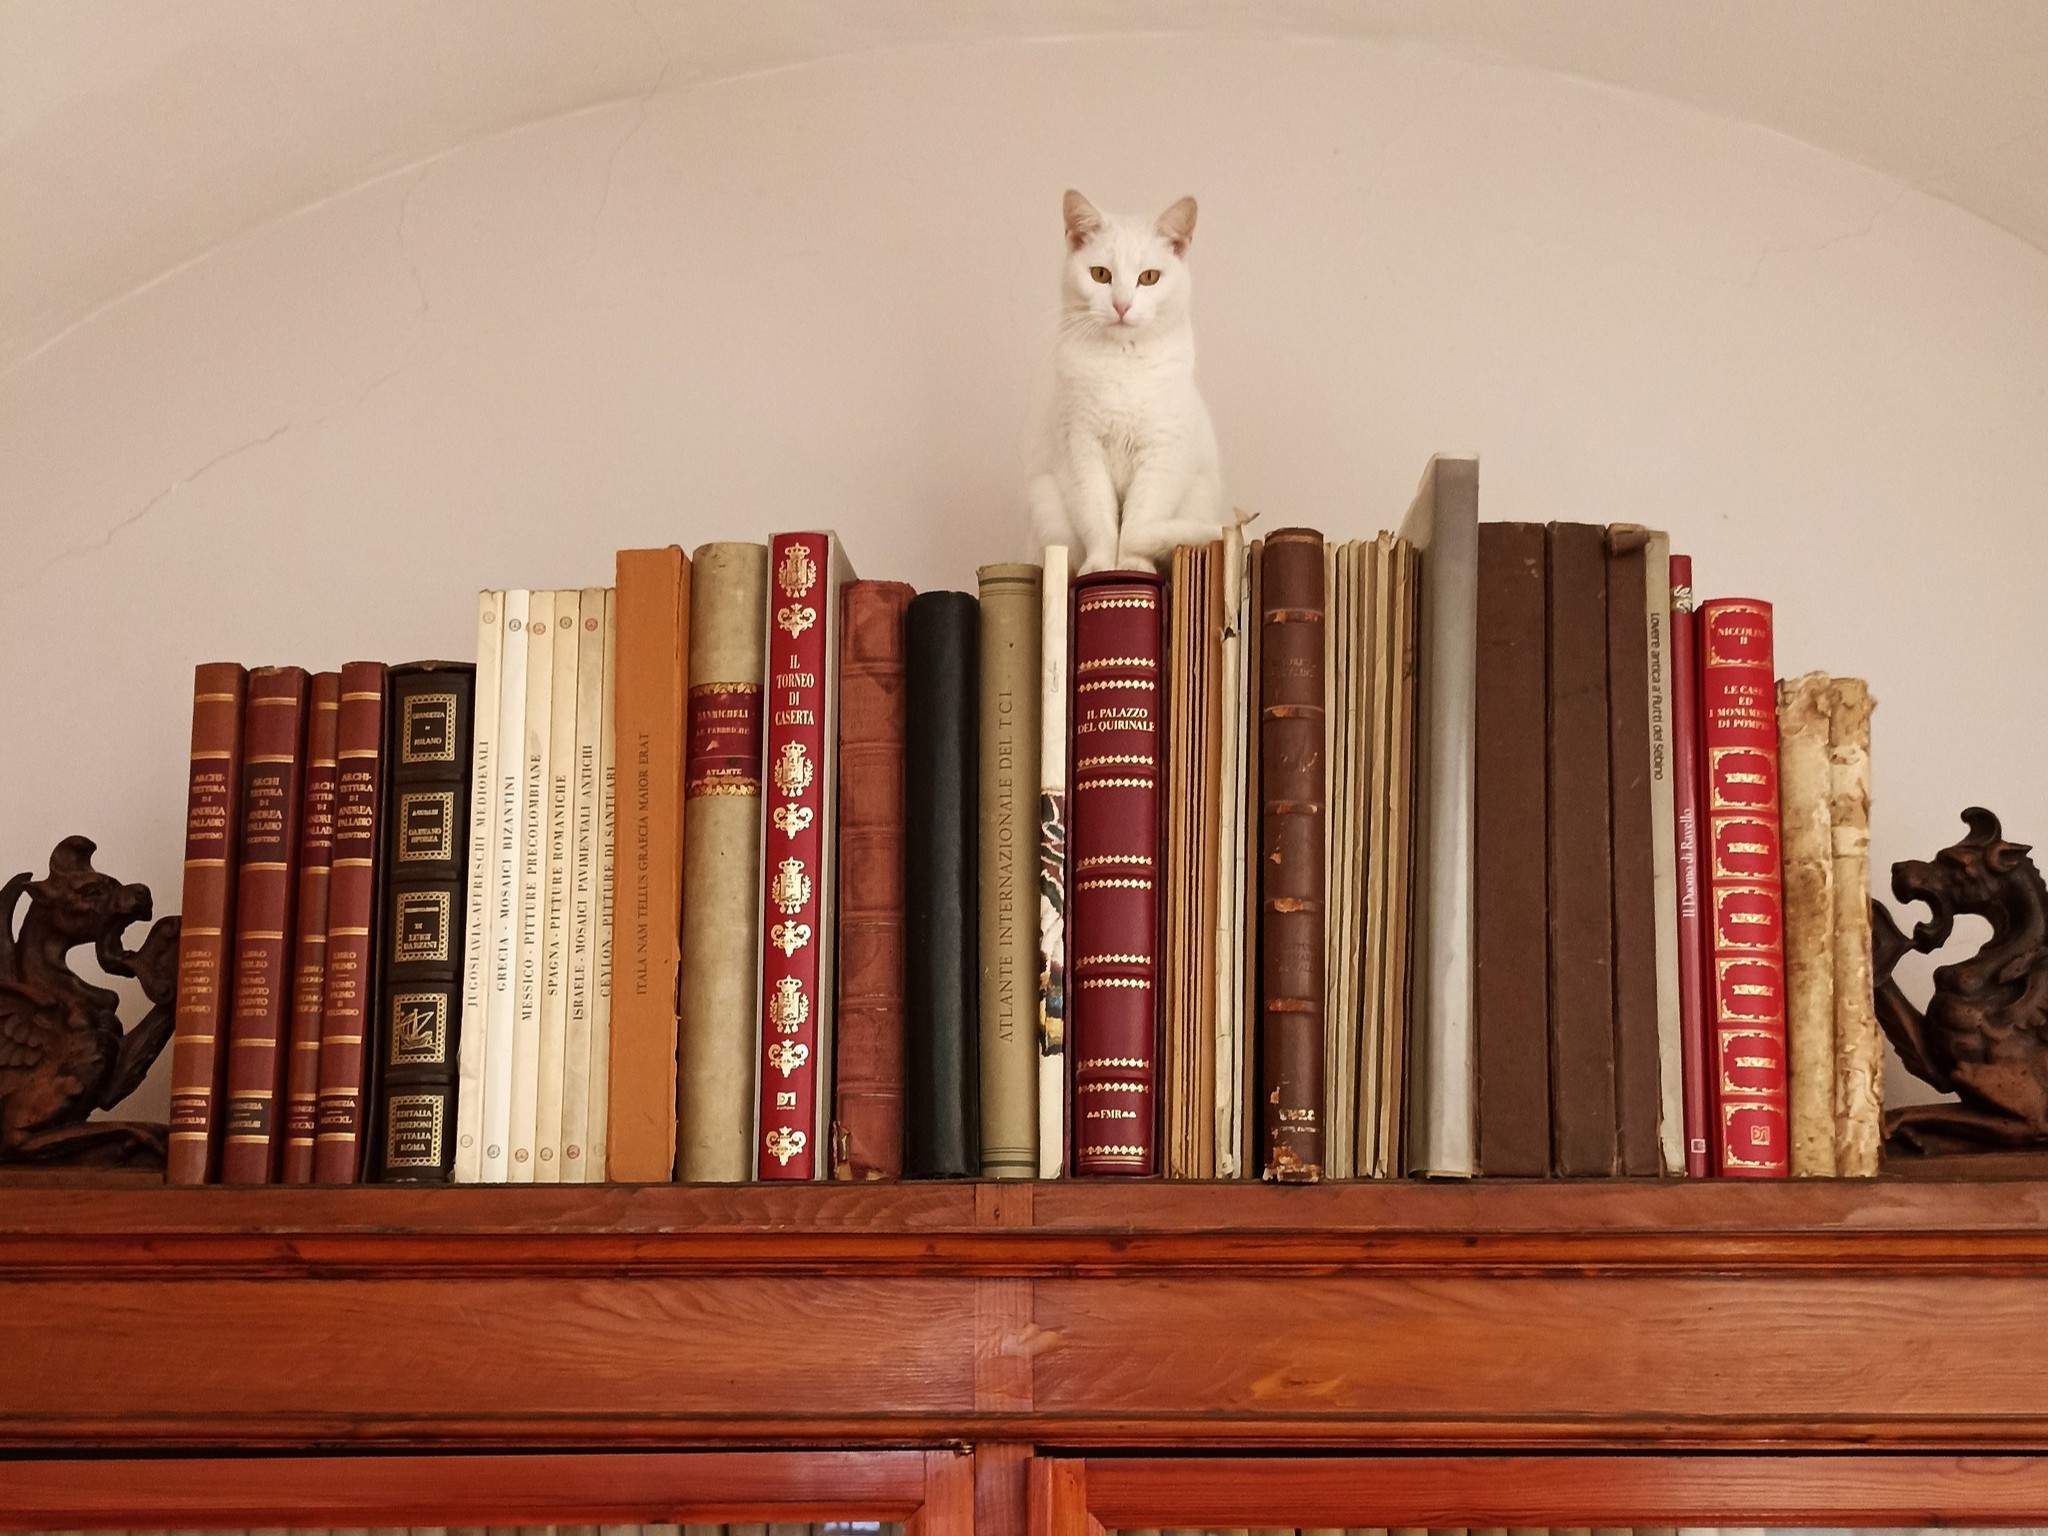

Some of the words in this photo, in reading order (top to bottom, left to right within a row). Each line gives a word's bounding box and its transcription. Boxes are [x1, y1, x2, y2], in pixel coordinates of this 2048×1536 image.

[1650, 612, 1661, 648] Lovere
[776, 672, 815, 689] TORNEO
[789, 654, 801, 670] IL
[1651, 650, 1662, 684] antica
[788, 691, 800, 706] DI
[1724, 685, 1739, 695] LE
[1738, 696, 1754, 706] ED
[775, 709, 815, 726] CASERTA
[1077, 721, 1097, 735] DEL
[1098, 719, 1156, 733] QUIRINALE
[1086, 709, 1098, 720] IL
[1099, 707, 1149, 719] PALAZZO
[1718, 719, 1730, 729] DI
[638, 733, 649, 766] ERAT
[998, 735, 1013, 771] DEL
[1653, 743, 1664, 781] Sebino
[476, 741, 489, 828] MEDIOEVALI
[581, 744, 593, 799] ANTICHI
[638, 769, 649, 812] MAIOR
[706, 768, 743, 776] ATLANTE
[190, 806, 226, 817] ANDREA
[338, 805, 373, 816] ANDREA
[349, 794, 359, 802] DI
[502, 776, 515, 851] BIZANTINI
[526, 753, 542, 876] PRECOLOMBIANE
[604, 766, 616, 838] SANTUARI
[337, 817, 373, 828] PALLADIO
[552, 774, 567, 861] ROMANICHE
[1679, 807, 1693, 851] Ravello
[577, 805, 591, 893] PAVIMENTALI
[604, 842, 615, 859] DI
[637, 815, 649, 872] GRAECIA
[998, 778, 1014, 947] INTERNAZIONALE
[1680, 852, 1694, 865] di
[500, 859, 512, 919] MOSAICI
[550, 866, 563, 930] PITTURE
[602, 865, 614, 927] PITTURE
[637, 874, 649, 919] TELLUS
[1681, 866, 1696, 907] Duomo
[524, 881, 537, 945] PITTURE
[575, 900, 588, 954] MOSAICI
[1682, 908, 1696, 918] Il
[637, 923, 648, 954] NAM
[496, 937, 509, 992] GRECIA
[547, 940, 560, 997] SPAGNA
[600, 939, 612, 998] CEYLON
[636, 957, 648, 996] ITALA
[521, 958, 535, 1022] MESSICO
[572, 965, 585, 1021] ISRAELE
[999, 955, 1014, 1044] ATLANTE
[1100, 1109, 1122, 1119] FMR
[400, 1142, 426, 1152] ROMA
